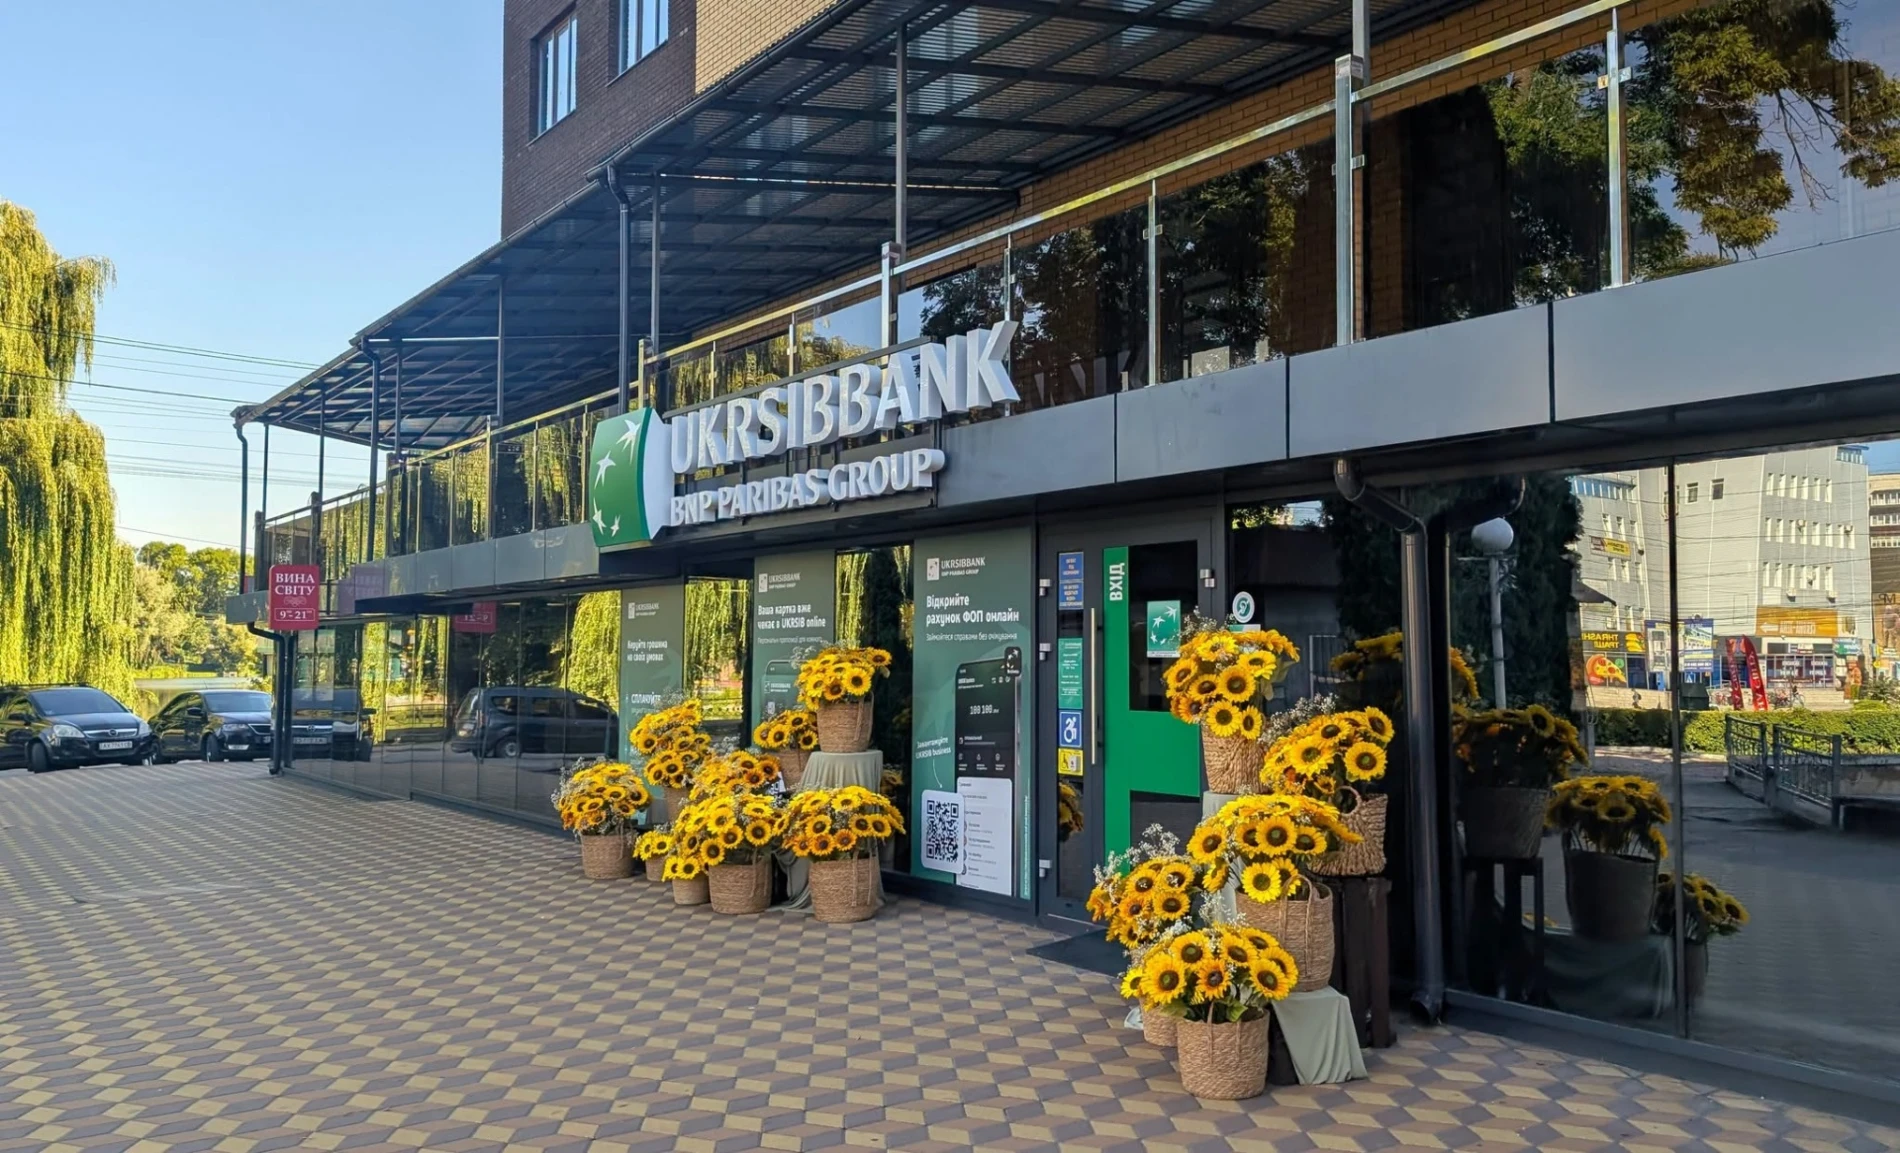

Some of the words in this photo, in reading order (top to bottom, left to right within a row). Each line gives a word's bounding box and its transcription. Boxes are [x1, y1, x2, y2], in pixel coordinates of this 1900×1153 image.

[671, 320, 1021, 474] UKRSIBBANK
[671, 490, 717, 526] BNP
[718, 468, 830, 518] PARIBAS
[828, 448, 945, 501] GROUP
[941, 556, 986, 569] UKRSIBBANK
[275, 573, 315, 584] ВИНА
[1109, 562, 1125, 601] ВХІД
[275, 585, 315, 596] СВІТУ
[926, 593, 970, 610] Відкрийте
[758, 605, 774, 615] Ваша
[775, 605, 796, 617] картка
[797, 604, 811, 613] вже
[926, 612, 961, 628] рахунок
[962, 610, 983, 623] ФОП
[986, 608, 1020, 622] онлайн
[781, 616, 805, 629] UKRSIB
